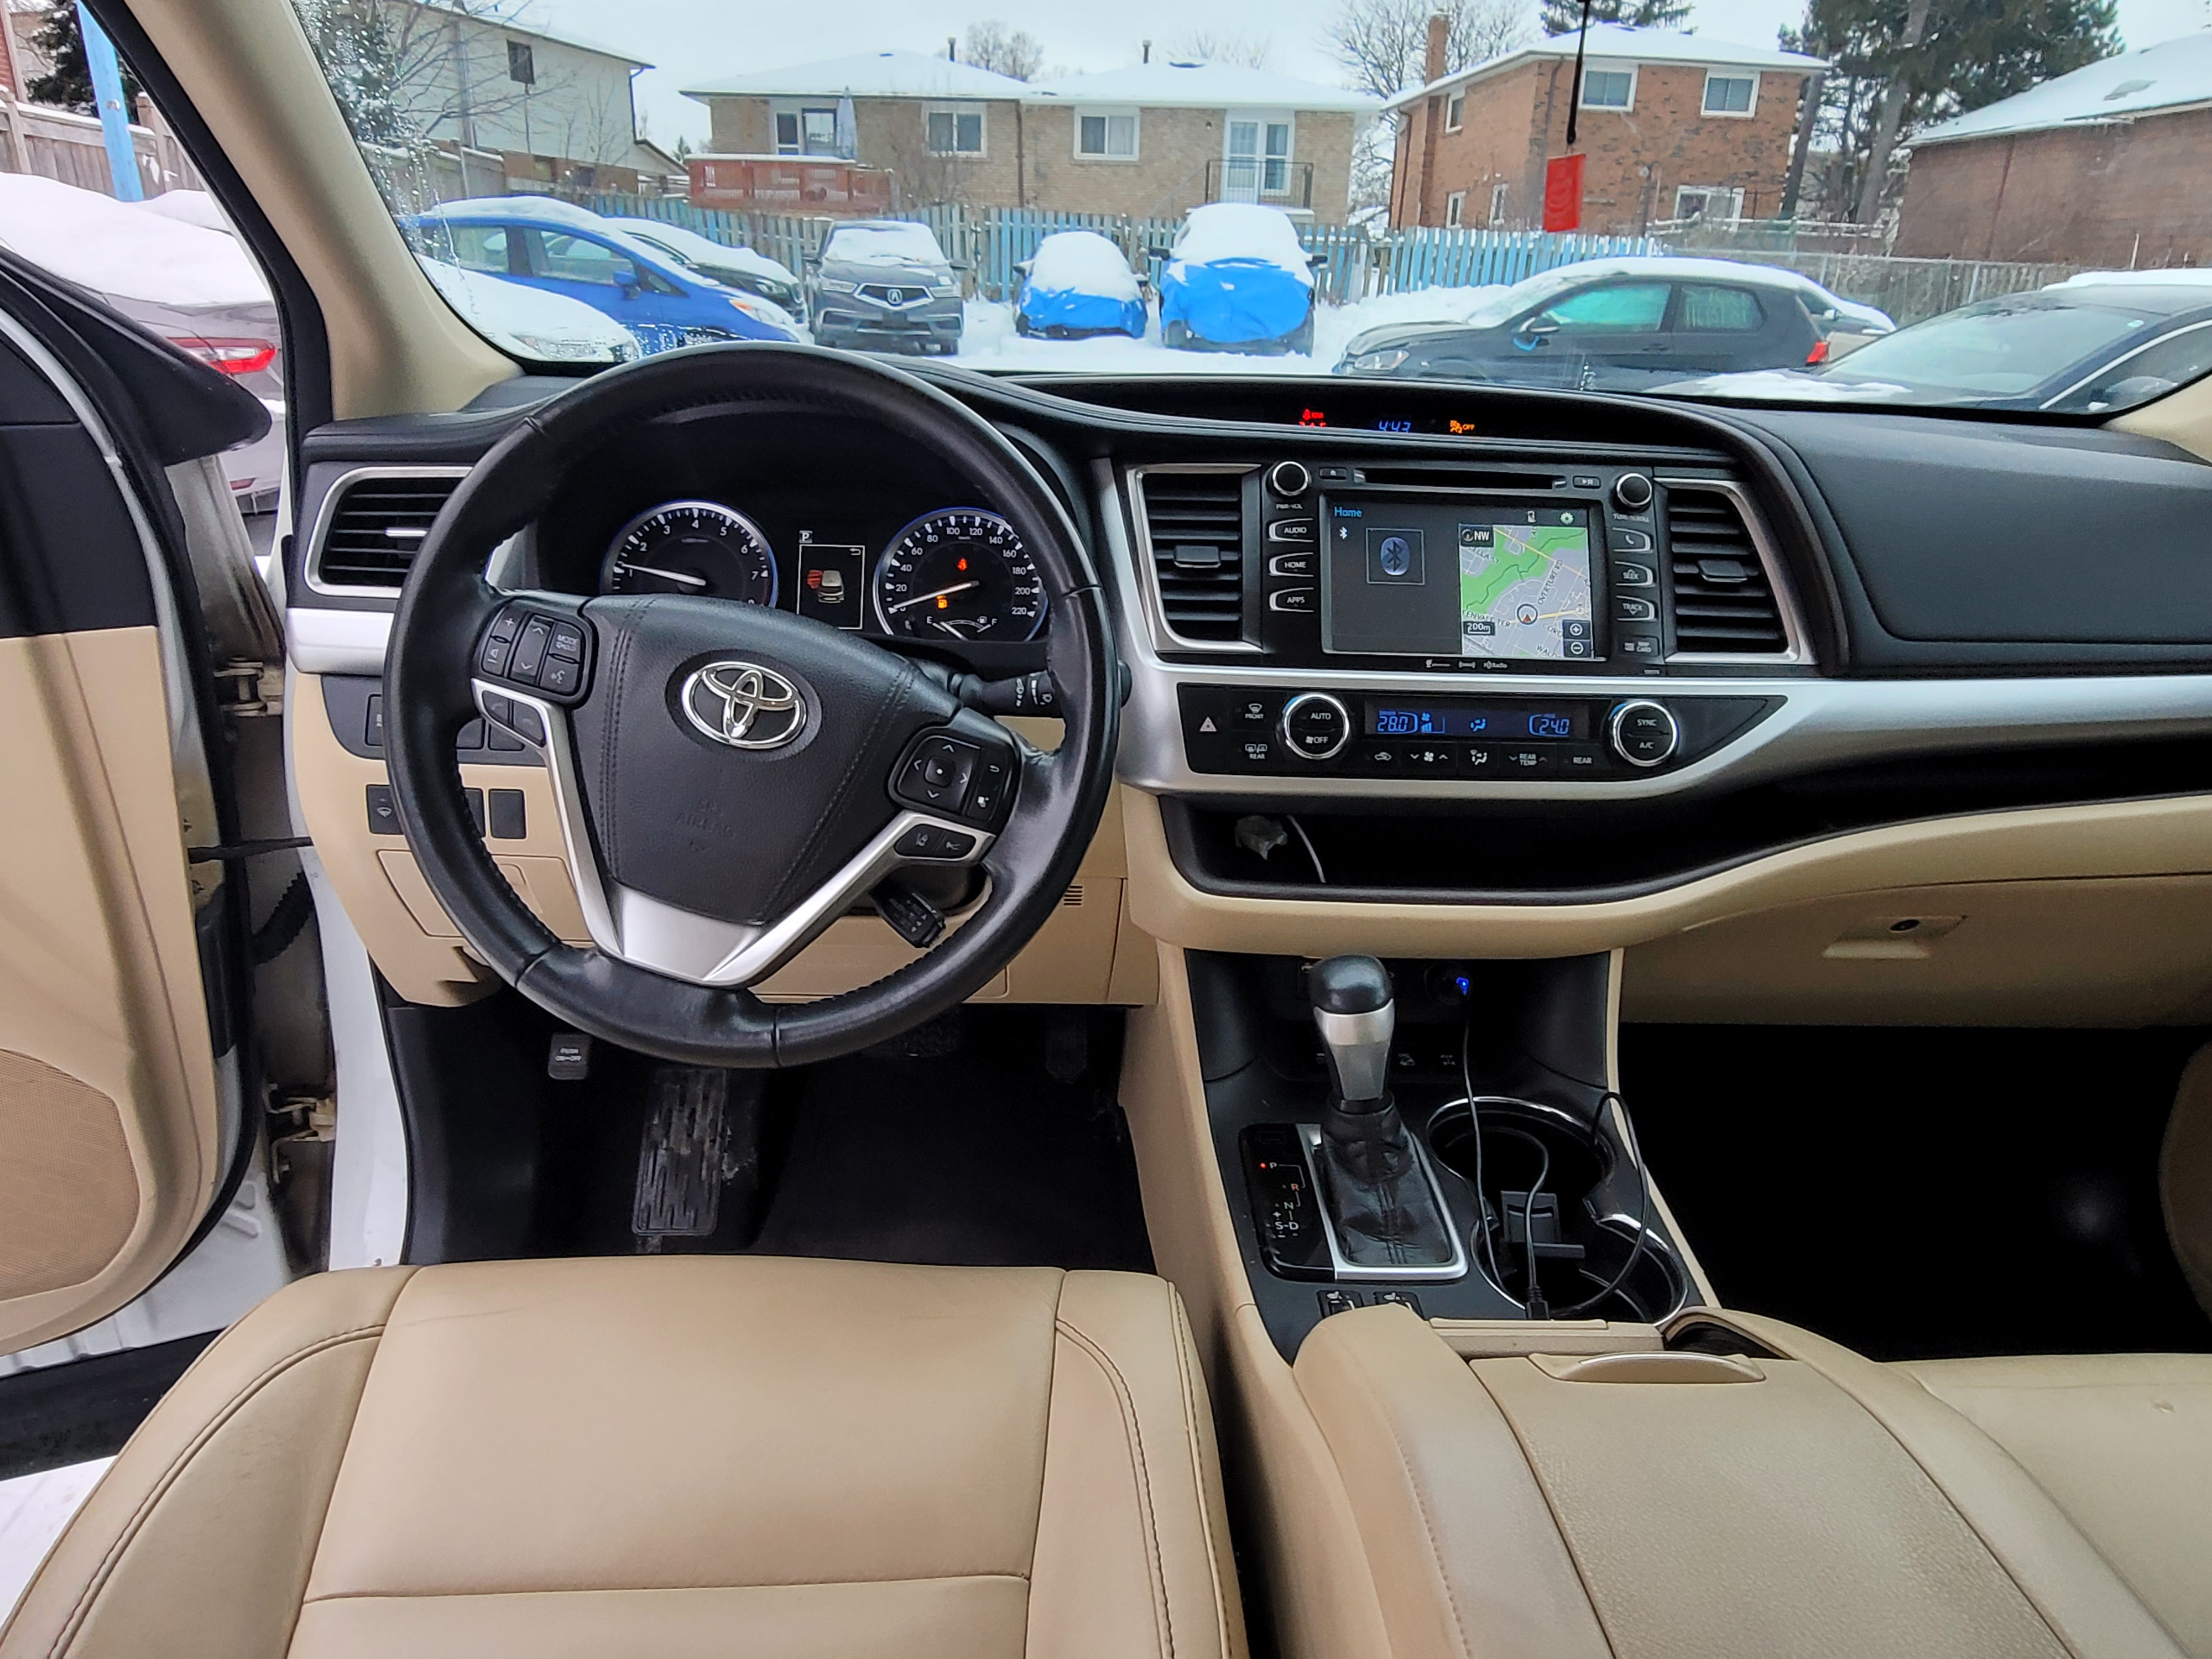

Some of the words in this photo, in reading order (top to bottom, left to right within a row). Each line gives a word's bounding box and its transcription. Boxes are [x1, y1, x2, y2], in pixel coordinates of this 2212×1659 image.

[1334, 506, 1362, 517] Home
[691, 519, 700, 529] 4
[663, 526, 671, 535] 3
[719, 526, 727, 536] 5
[946, 527, 960, 535] 100
[801, 531, 810, 542] P
[926, 534, 938, 542] 80
[989, 536, 1003, 544] 140
[1474, 530, 1490, 541] NW
[639, 543, 648, 551] 2
[740, 544, 748, 554] 6
[911, 547, 923, 555] 60
[1003, 549, 1016, 558] 160
[750, 571, 759, 580] 7
[1012, 567, 1026, 575] 180
[895, 583, 907, 592] 20
[1537, 570, 1558, 606] OVERTURE
[1554, 560, 1563, 570] RD
[1015, 587, 1031, 595] 200
[1011, 607, 1027, 615] 220
[1622, 603, 1642, 611] TRACK
[926, 615, 933, 624] E
[1498, 618, 1511, 627] TER
[557, 634, 579, 646] MODE
[1284, 1202, 1294, 1210] N
